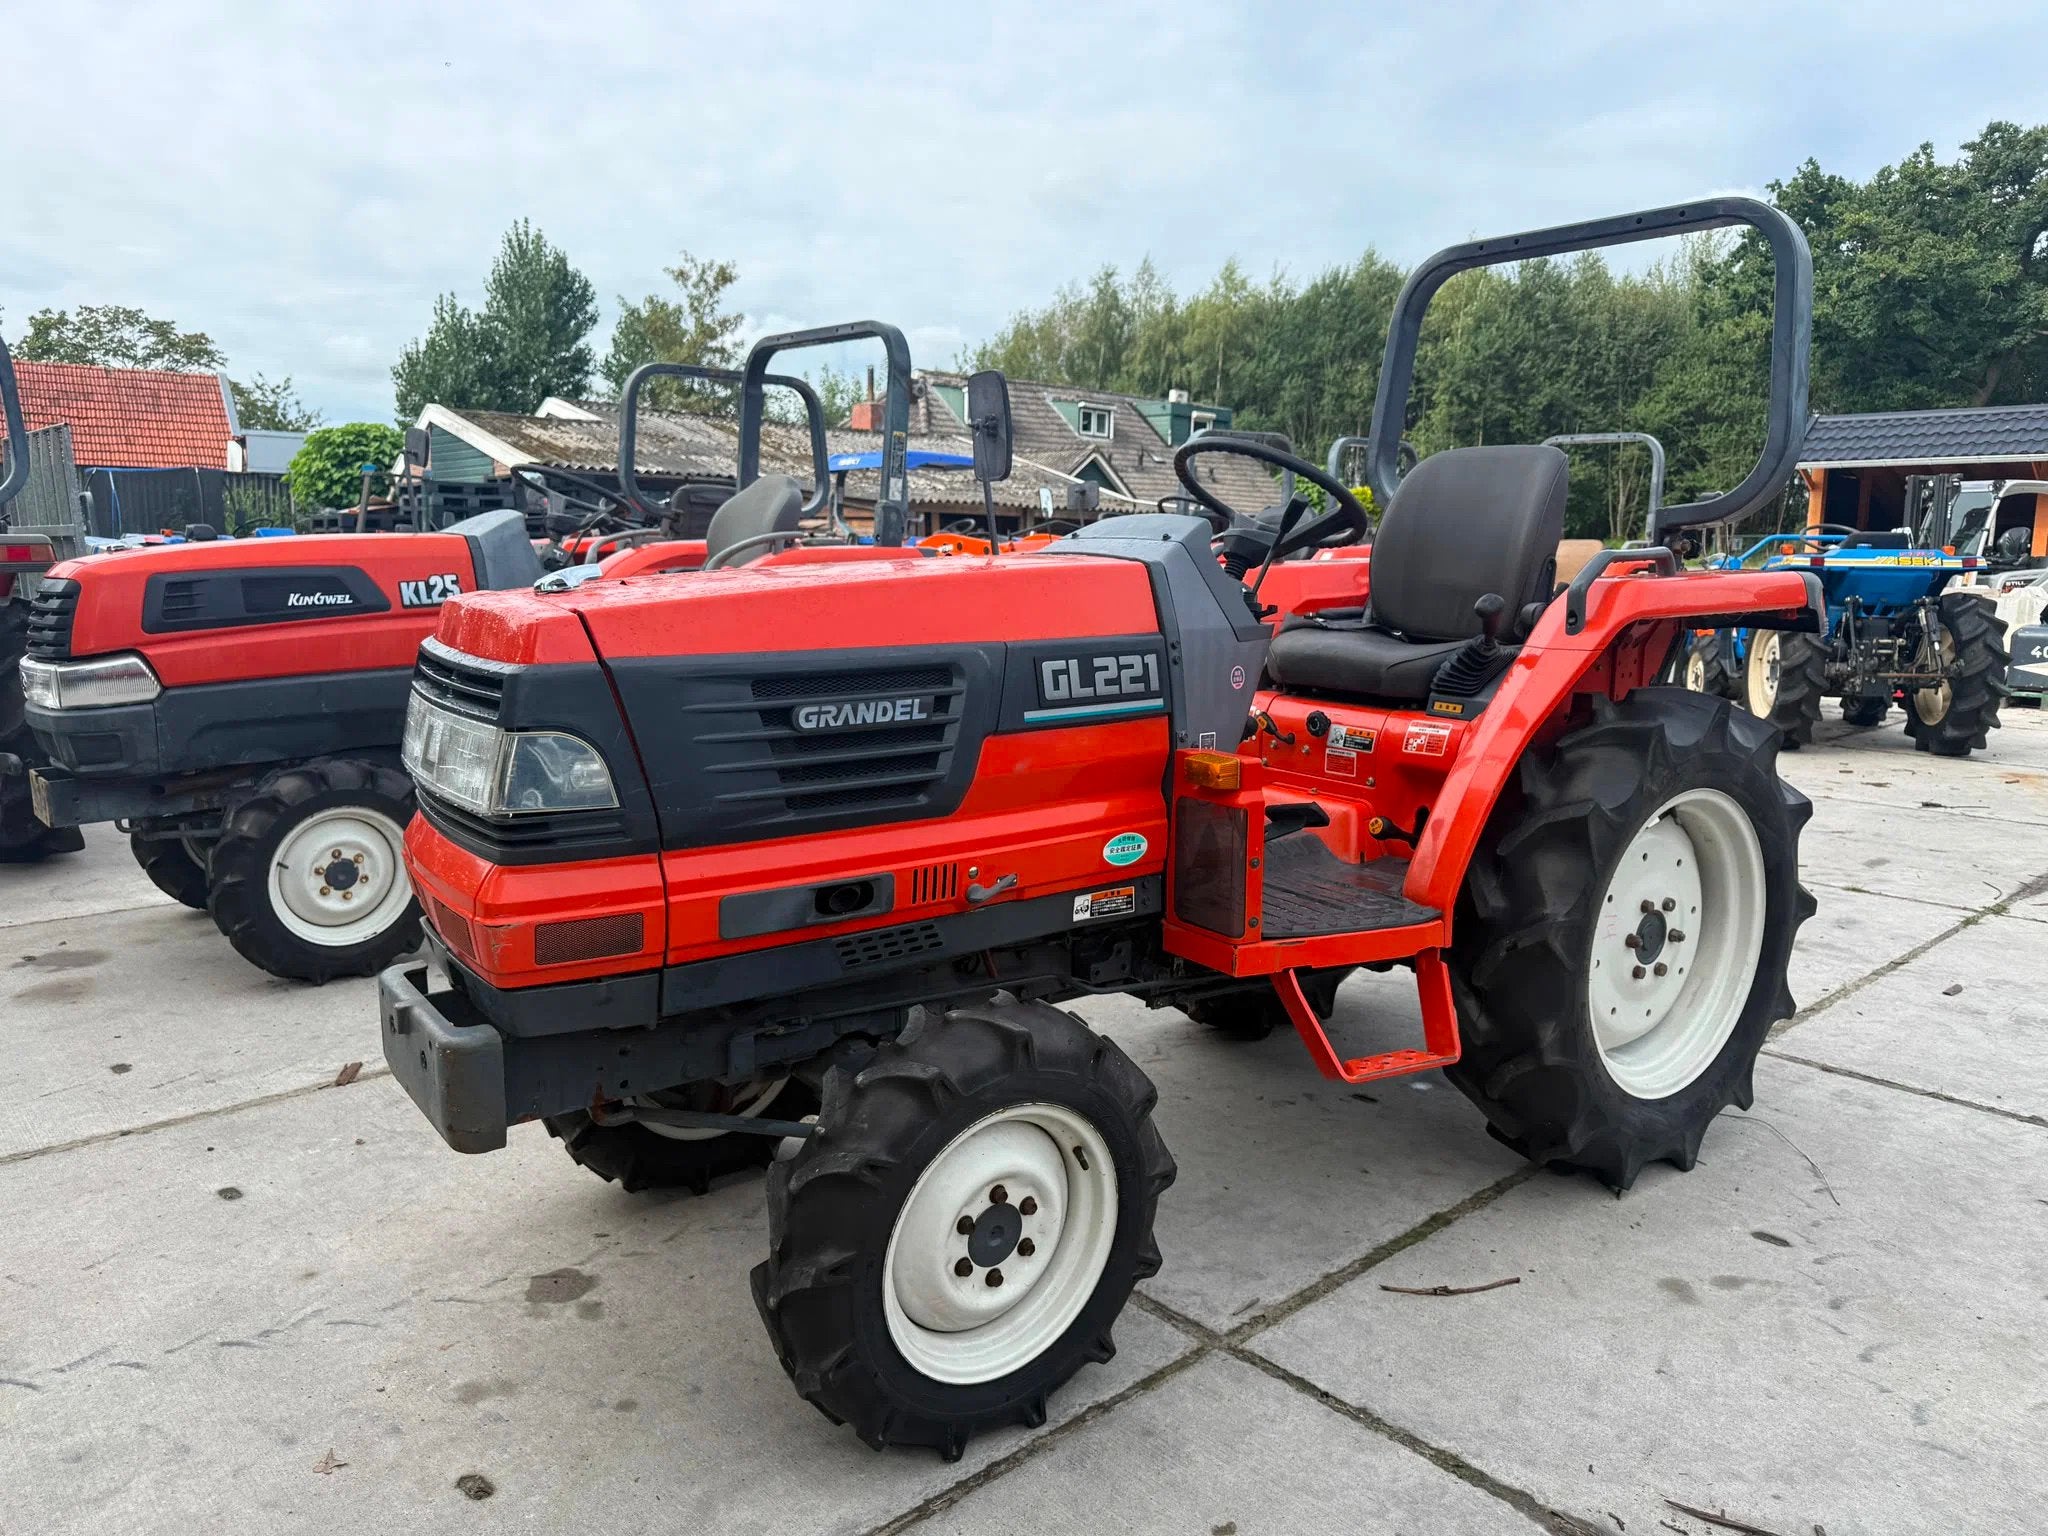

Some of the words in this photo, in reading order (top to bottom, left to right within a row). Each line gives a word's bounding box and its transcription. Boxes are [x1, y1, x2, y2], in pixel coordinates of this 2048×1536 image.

[399, 573, 462, 606] KL25
[1041, 653, 1160, 701] GL221
[799, 698, 927, 729] GRANDEL
